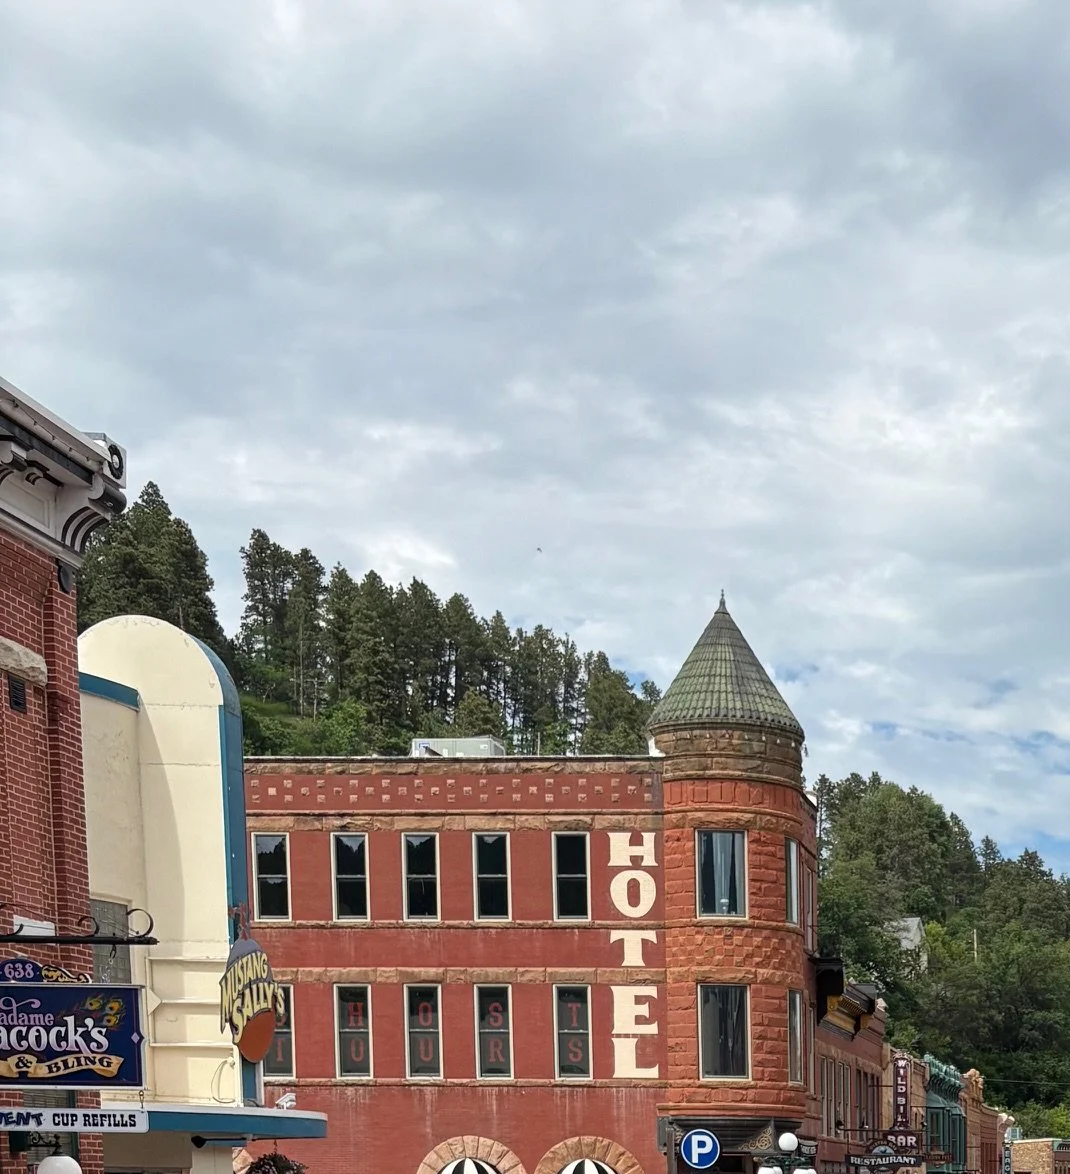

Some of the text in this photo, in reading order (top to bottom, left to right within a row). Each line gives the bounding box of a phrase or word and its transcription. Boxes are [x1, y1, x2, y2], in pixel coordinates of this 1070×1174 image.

[607, 832, 659, 1079] HOTEL
[4, 962, 35, 979] 638
[219, 951, 269, 1034] MUSTANG
[231, 982, 286, 1044] SALLY'S
[15, 1054, 114, 1075] & BLING
[0, 1111, 137, 1127] ENT CUP REFILLS
[691, 1134, 713, 1164] P
[887, 1135, 918, 1147] BAR
[850, 1156, 917, 1166] RESTAURANT
